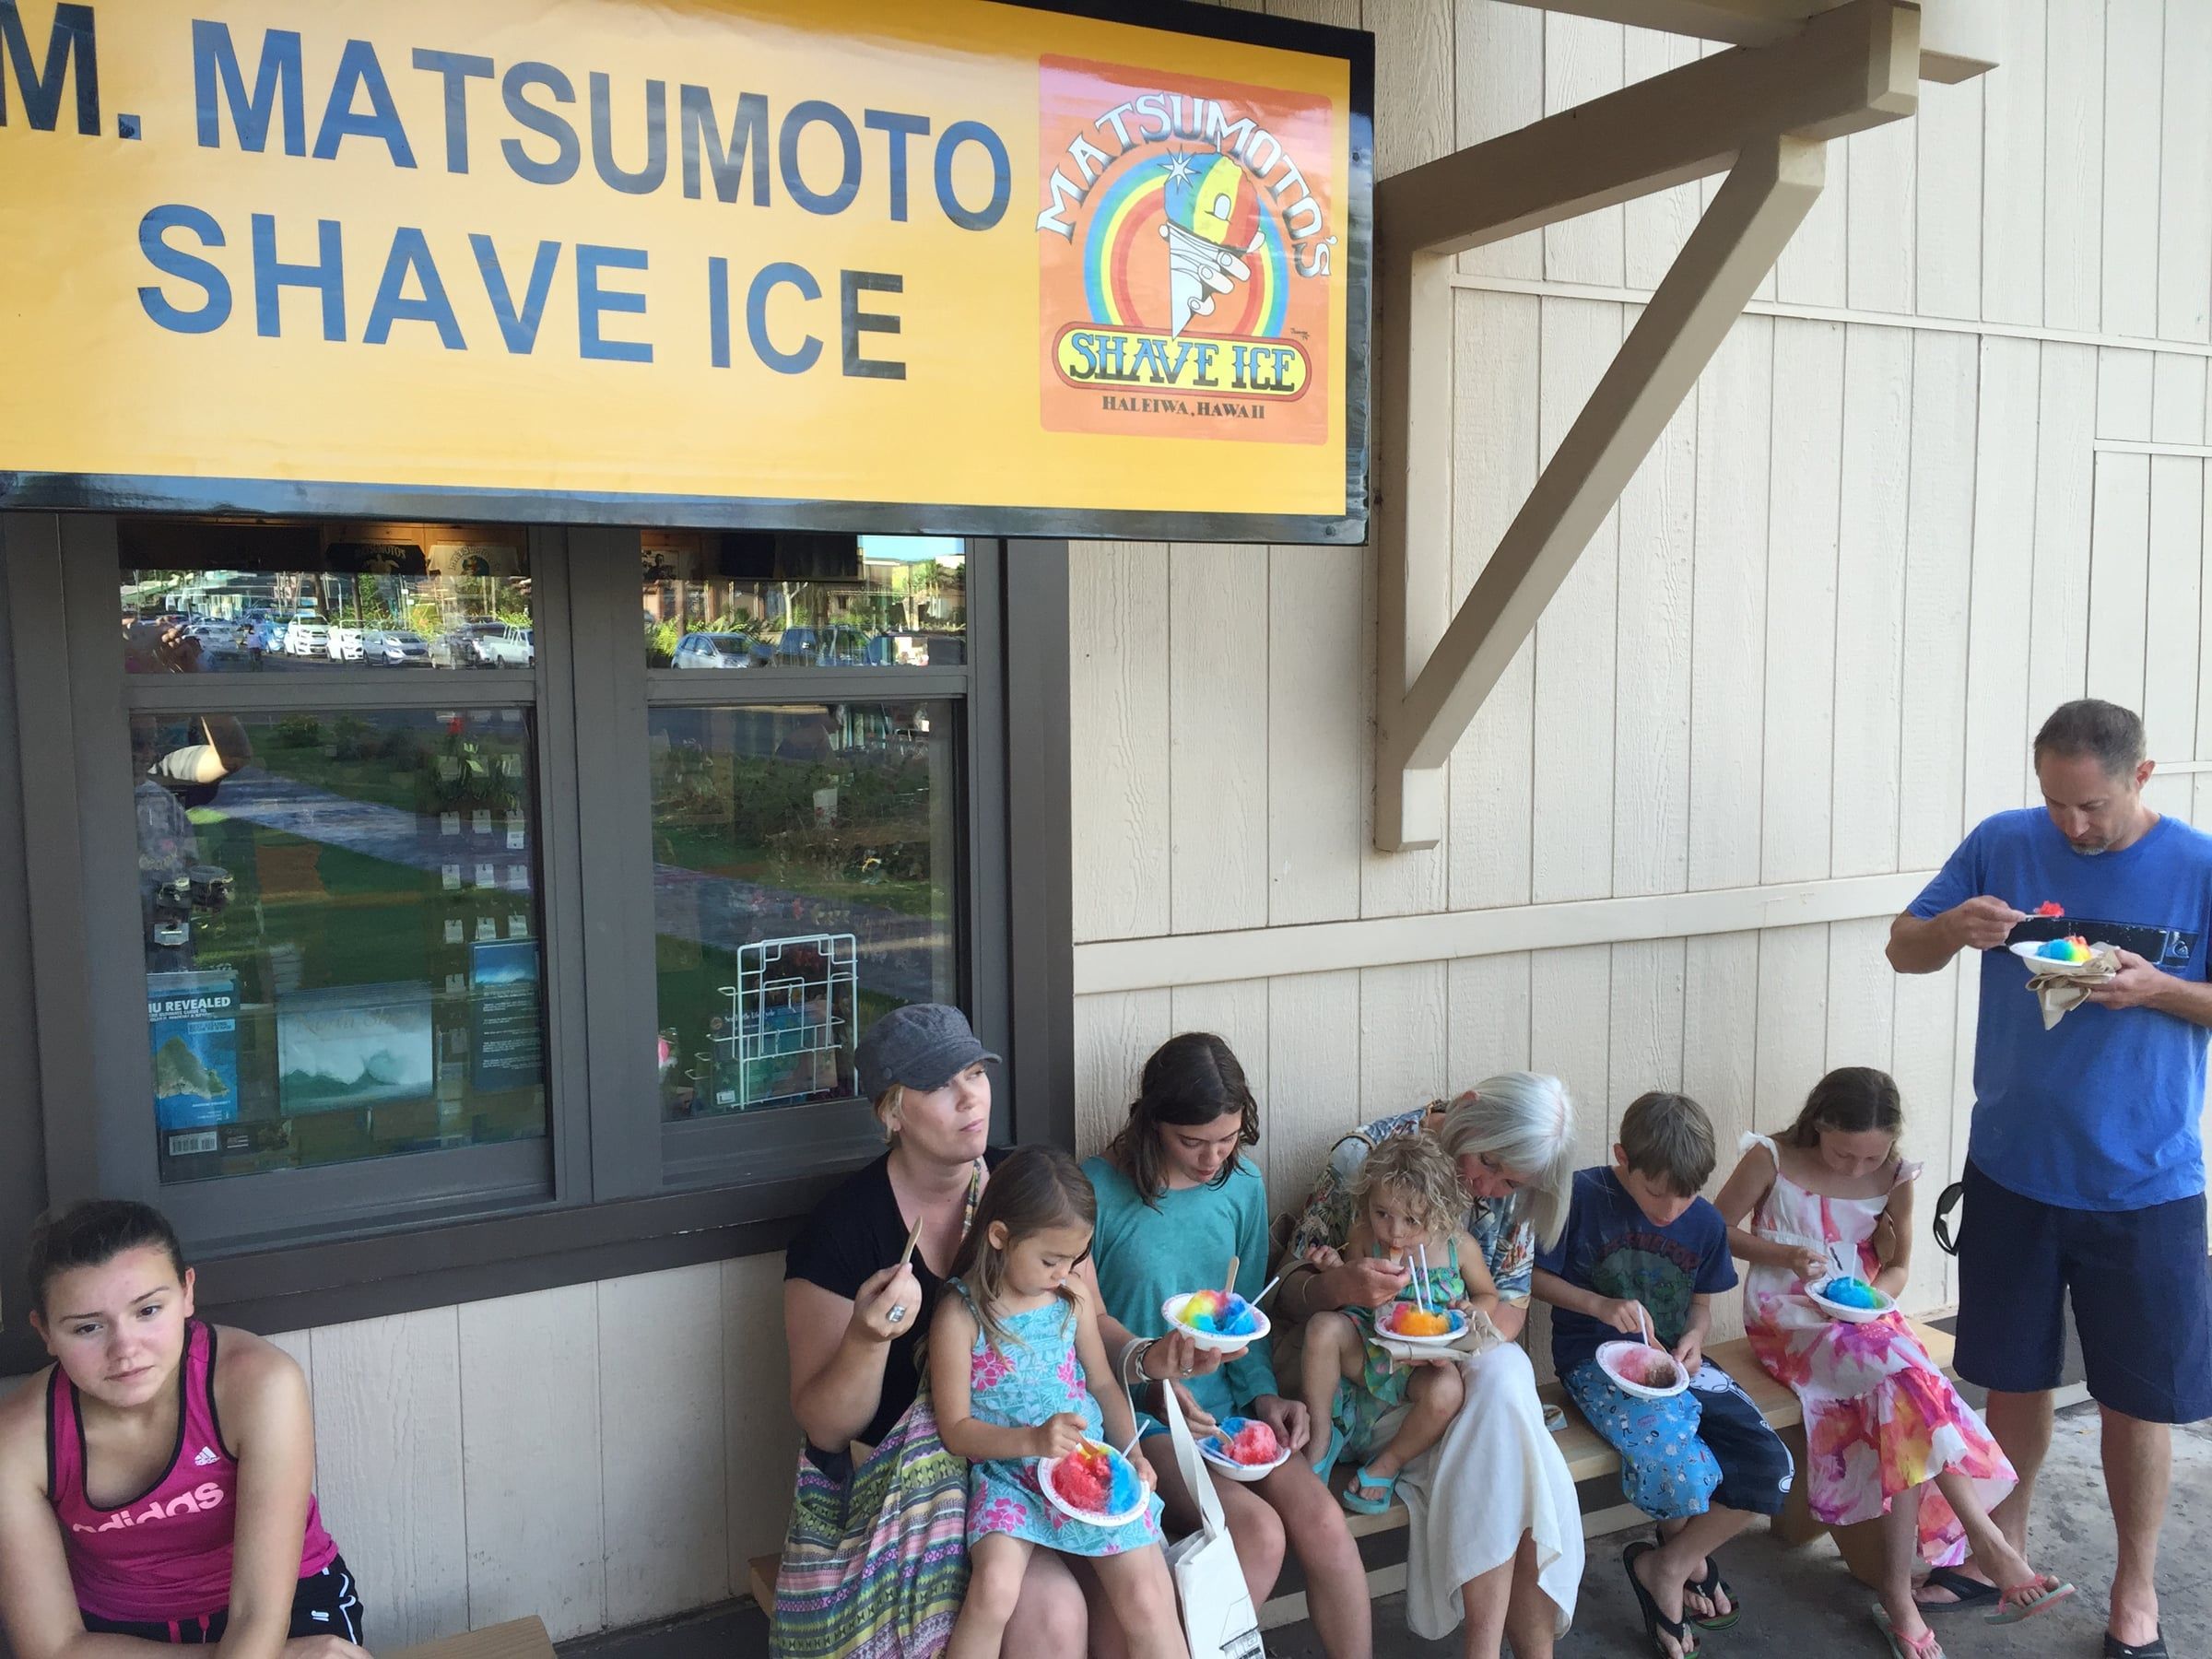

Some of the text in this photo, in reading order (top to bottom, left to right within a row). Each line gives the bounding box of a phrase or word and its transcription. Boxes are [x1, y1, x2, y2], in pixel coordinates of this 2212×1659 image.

[0, 0, 1012, 231] M. MATSUMOTO
[1036, 92, 1338, 277] MATSUMOTO'S
[138, 204, 907, 381] SHAVE ICE
[1069, 332, 1295, 392] SHAVE ICE
[1197, 401, 1265, 419] HAWAII
[165, 996, 231, 1012] REVEALED
